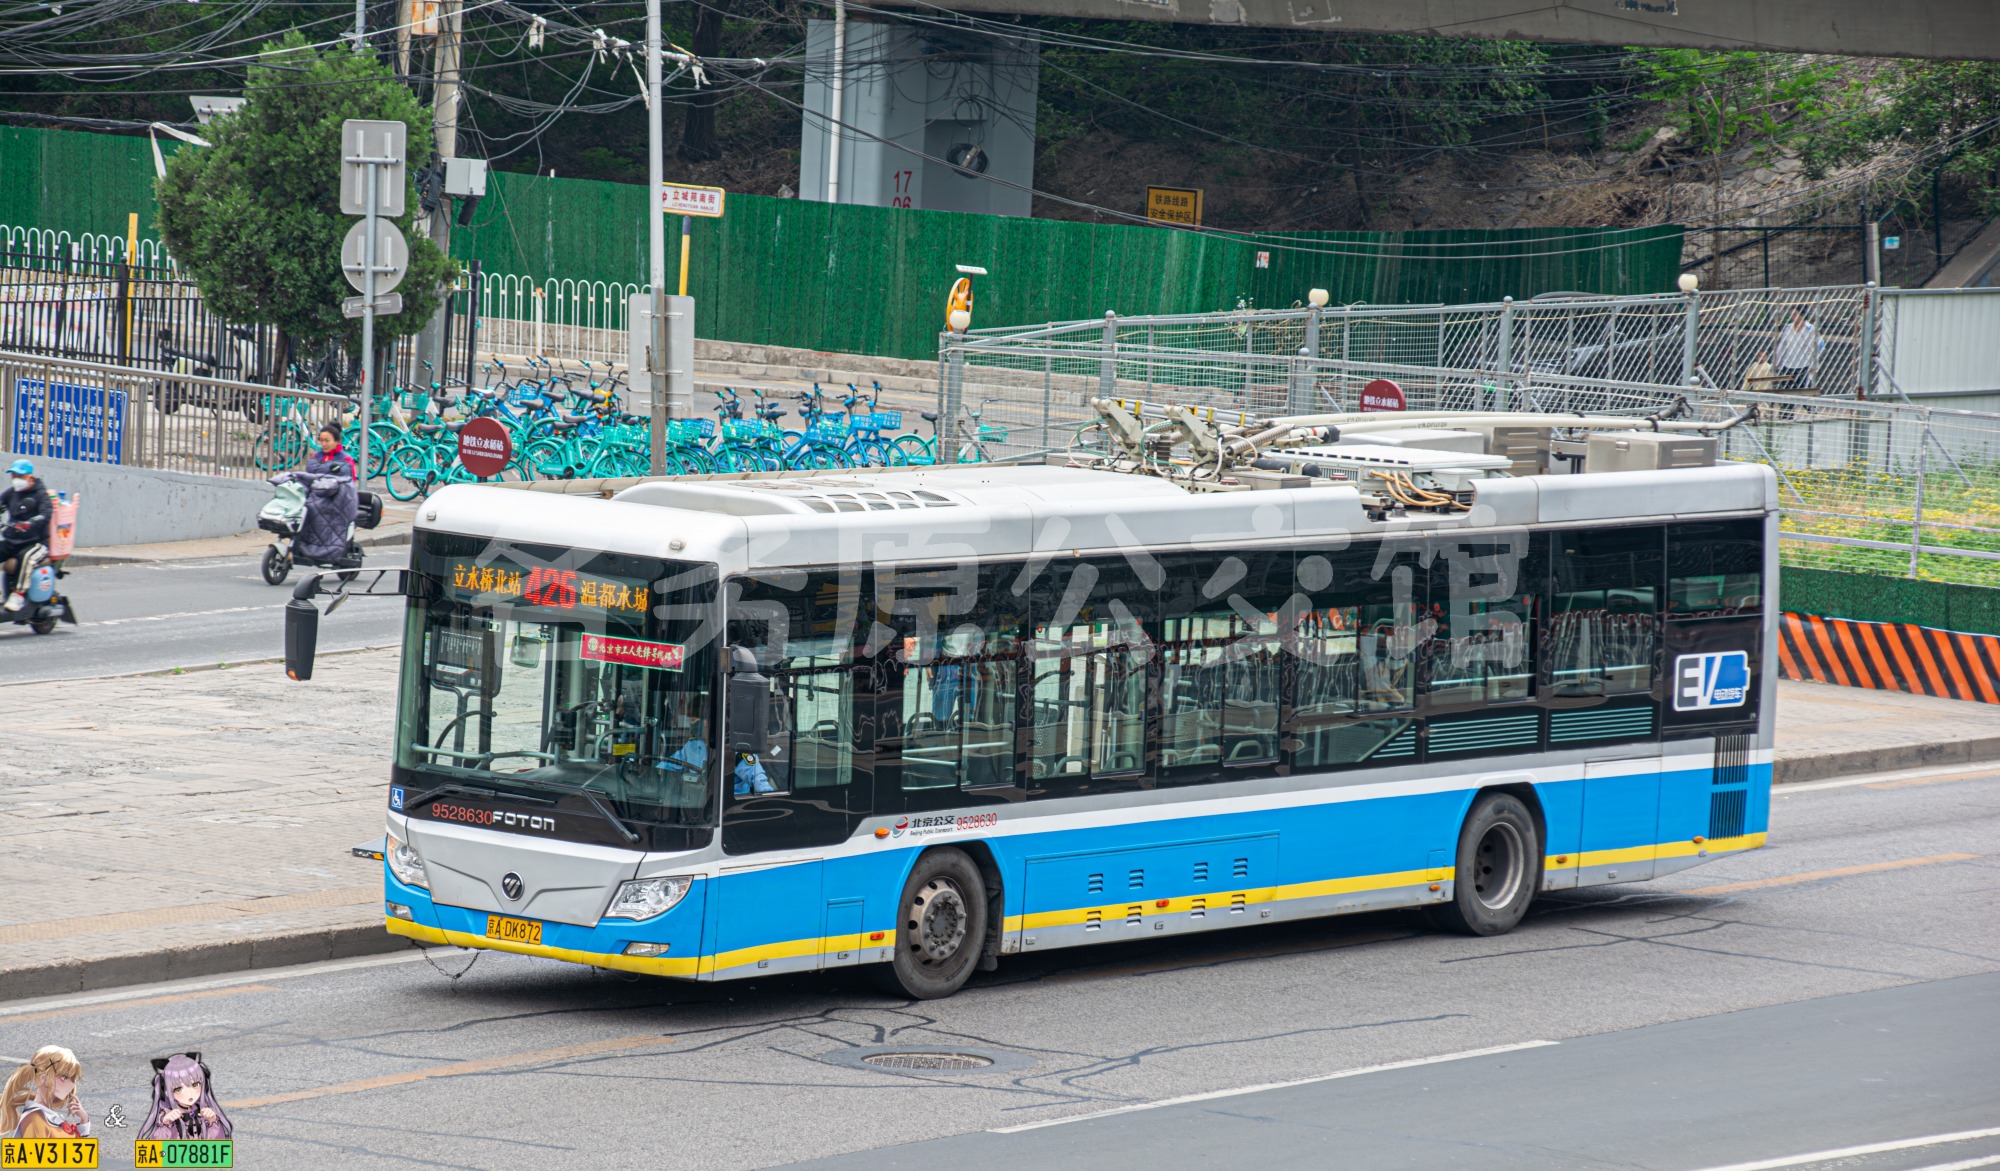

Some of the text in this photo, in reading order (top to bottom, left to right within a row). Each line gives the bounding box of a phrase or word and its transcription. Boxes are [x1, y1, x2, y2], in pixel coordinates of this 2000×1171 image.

[894, 171, 912, 193] 17
[673, 189, 715, 204] 立城苑南街
[1155, 194, 1189, 207] 铁路线路
[1150, 208, 1192, 222] 安全保护区
[453, 563, 649, 612] 立水桥北站 426 温都水城
[432, 803, 555, 832] 9528630 FOTON
[911, 812, 998, 831] 北京公交 9528630
